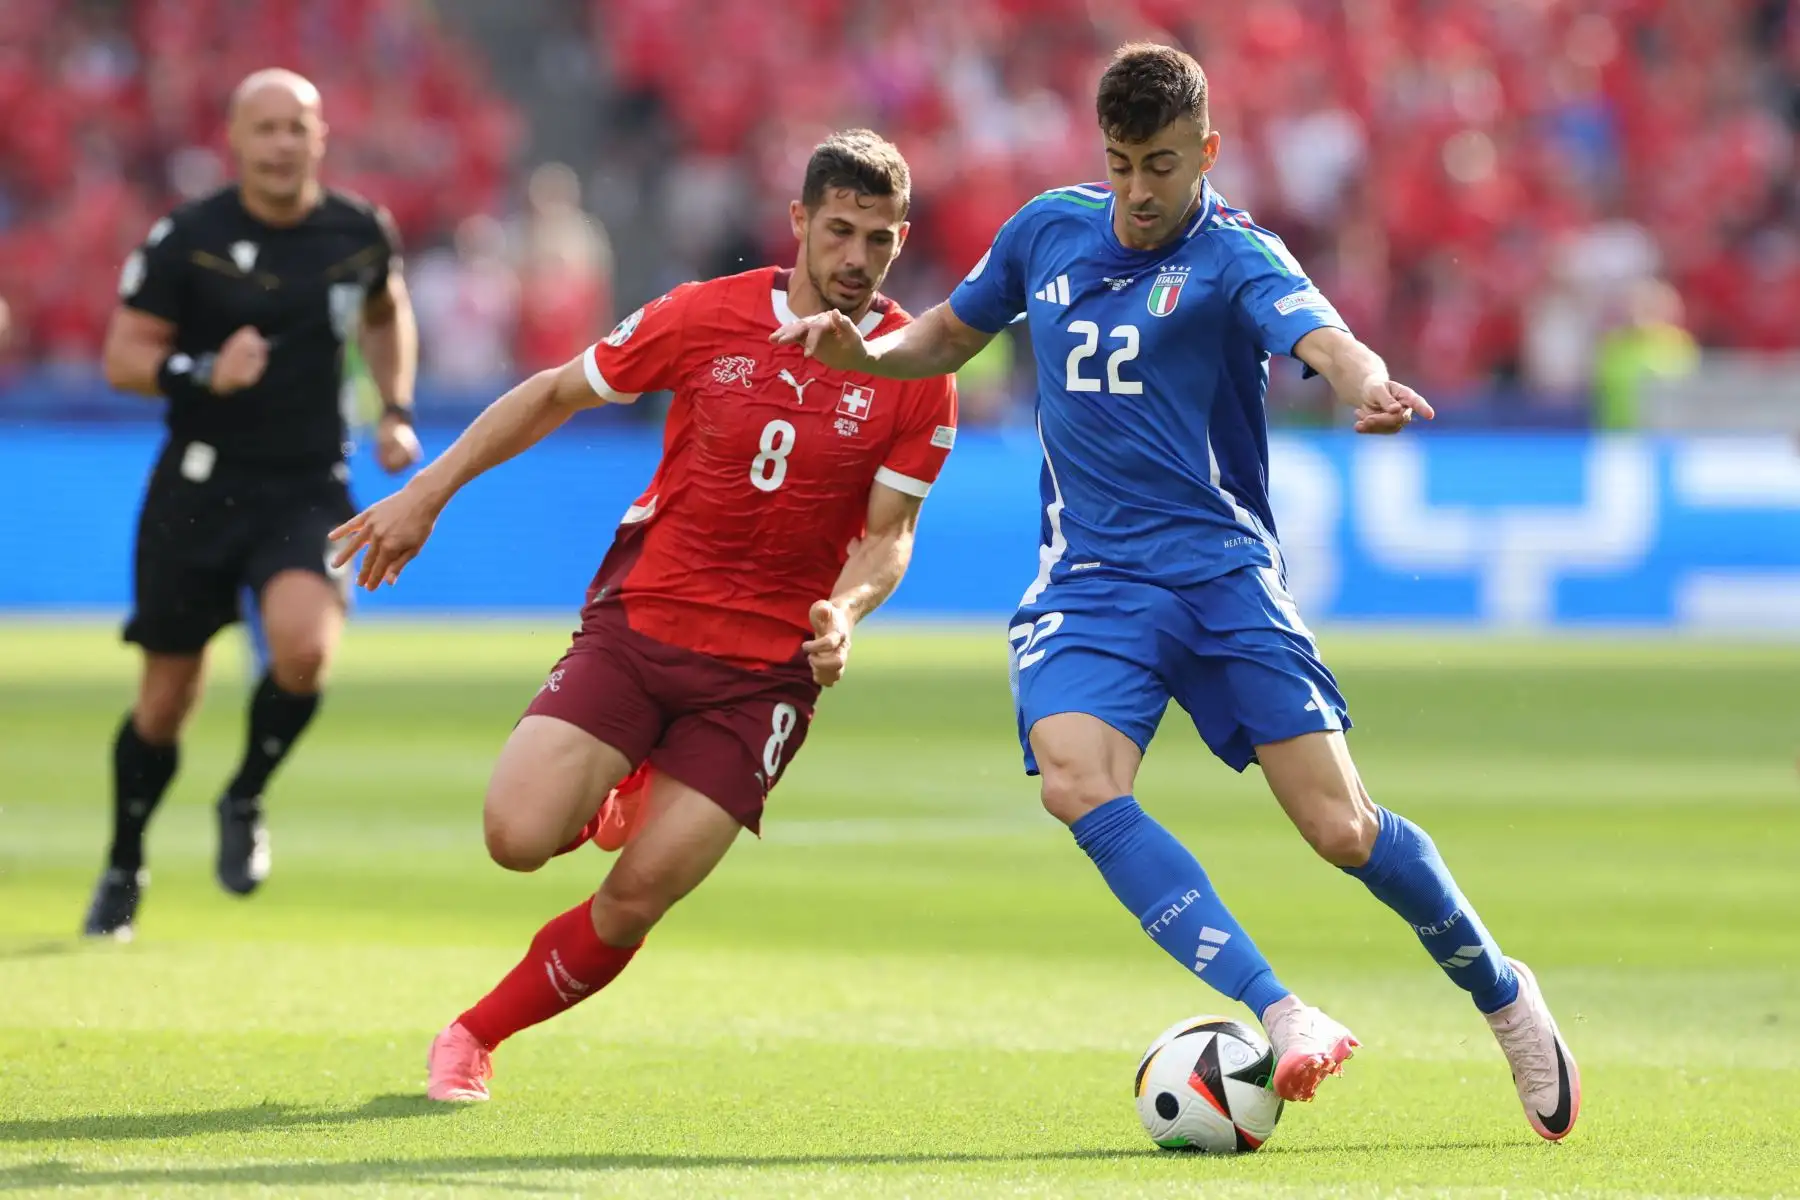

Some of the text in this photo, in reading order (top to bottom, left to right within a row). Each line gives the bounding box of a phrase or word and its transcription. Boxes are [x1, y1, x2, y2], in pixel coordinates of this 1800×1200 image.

[1158, 275, 1184, 284] ITALIA
[1066, 320, 1143, 394] 22
[750, 420, 796, 491] 8
[1009, 612, 1064, 670] 22
[763, 703, 796, 776] 8
[1410, 908, 1463, 937] TALIA
